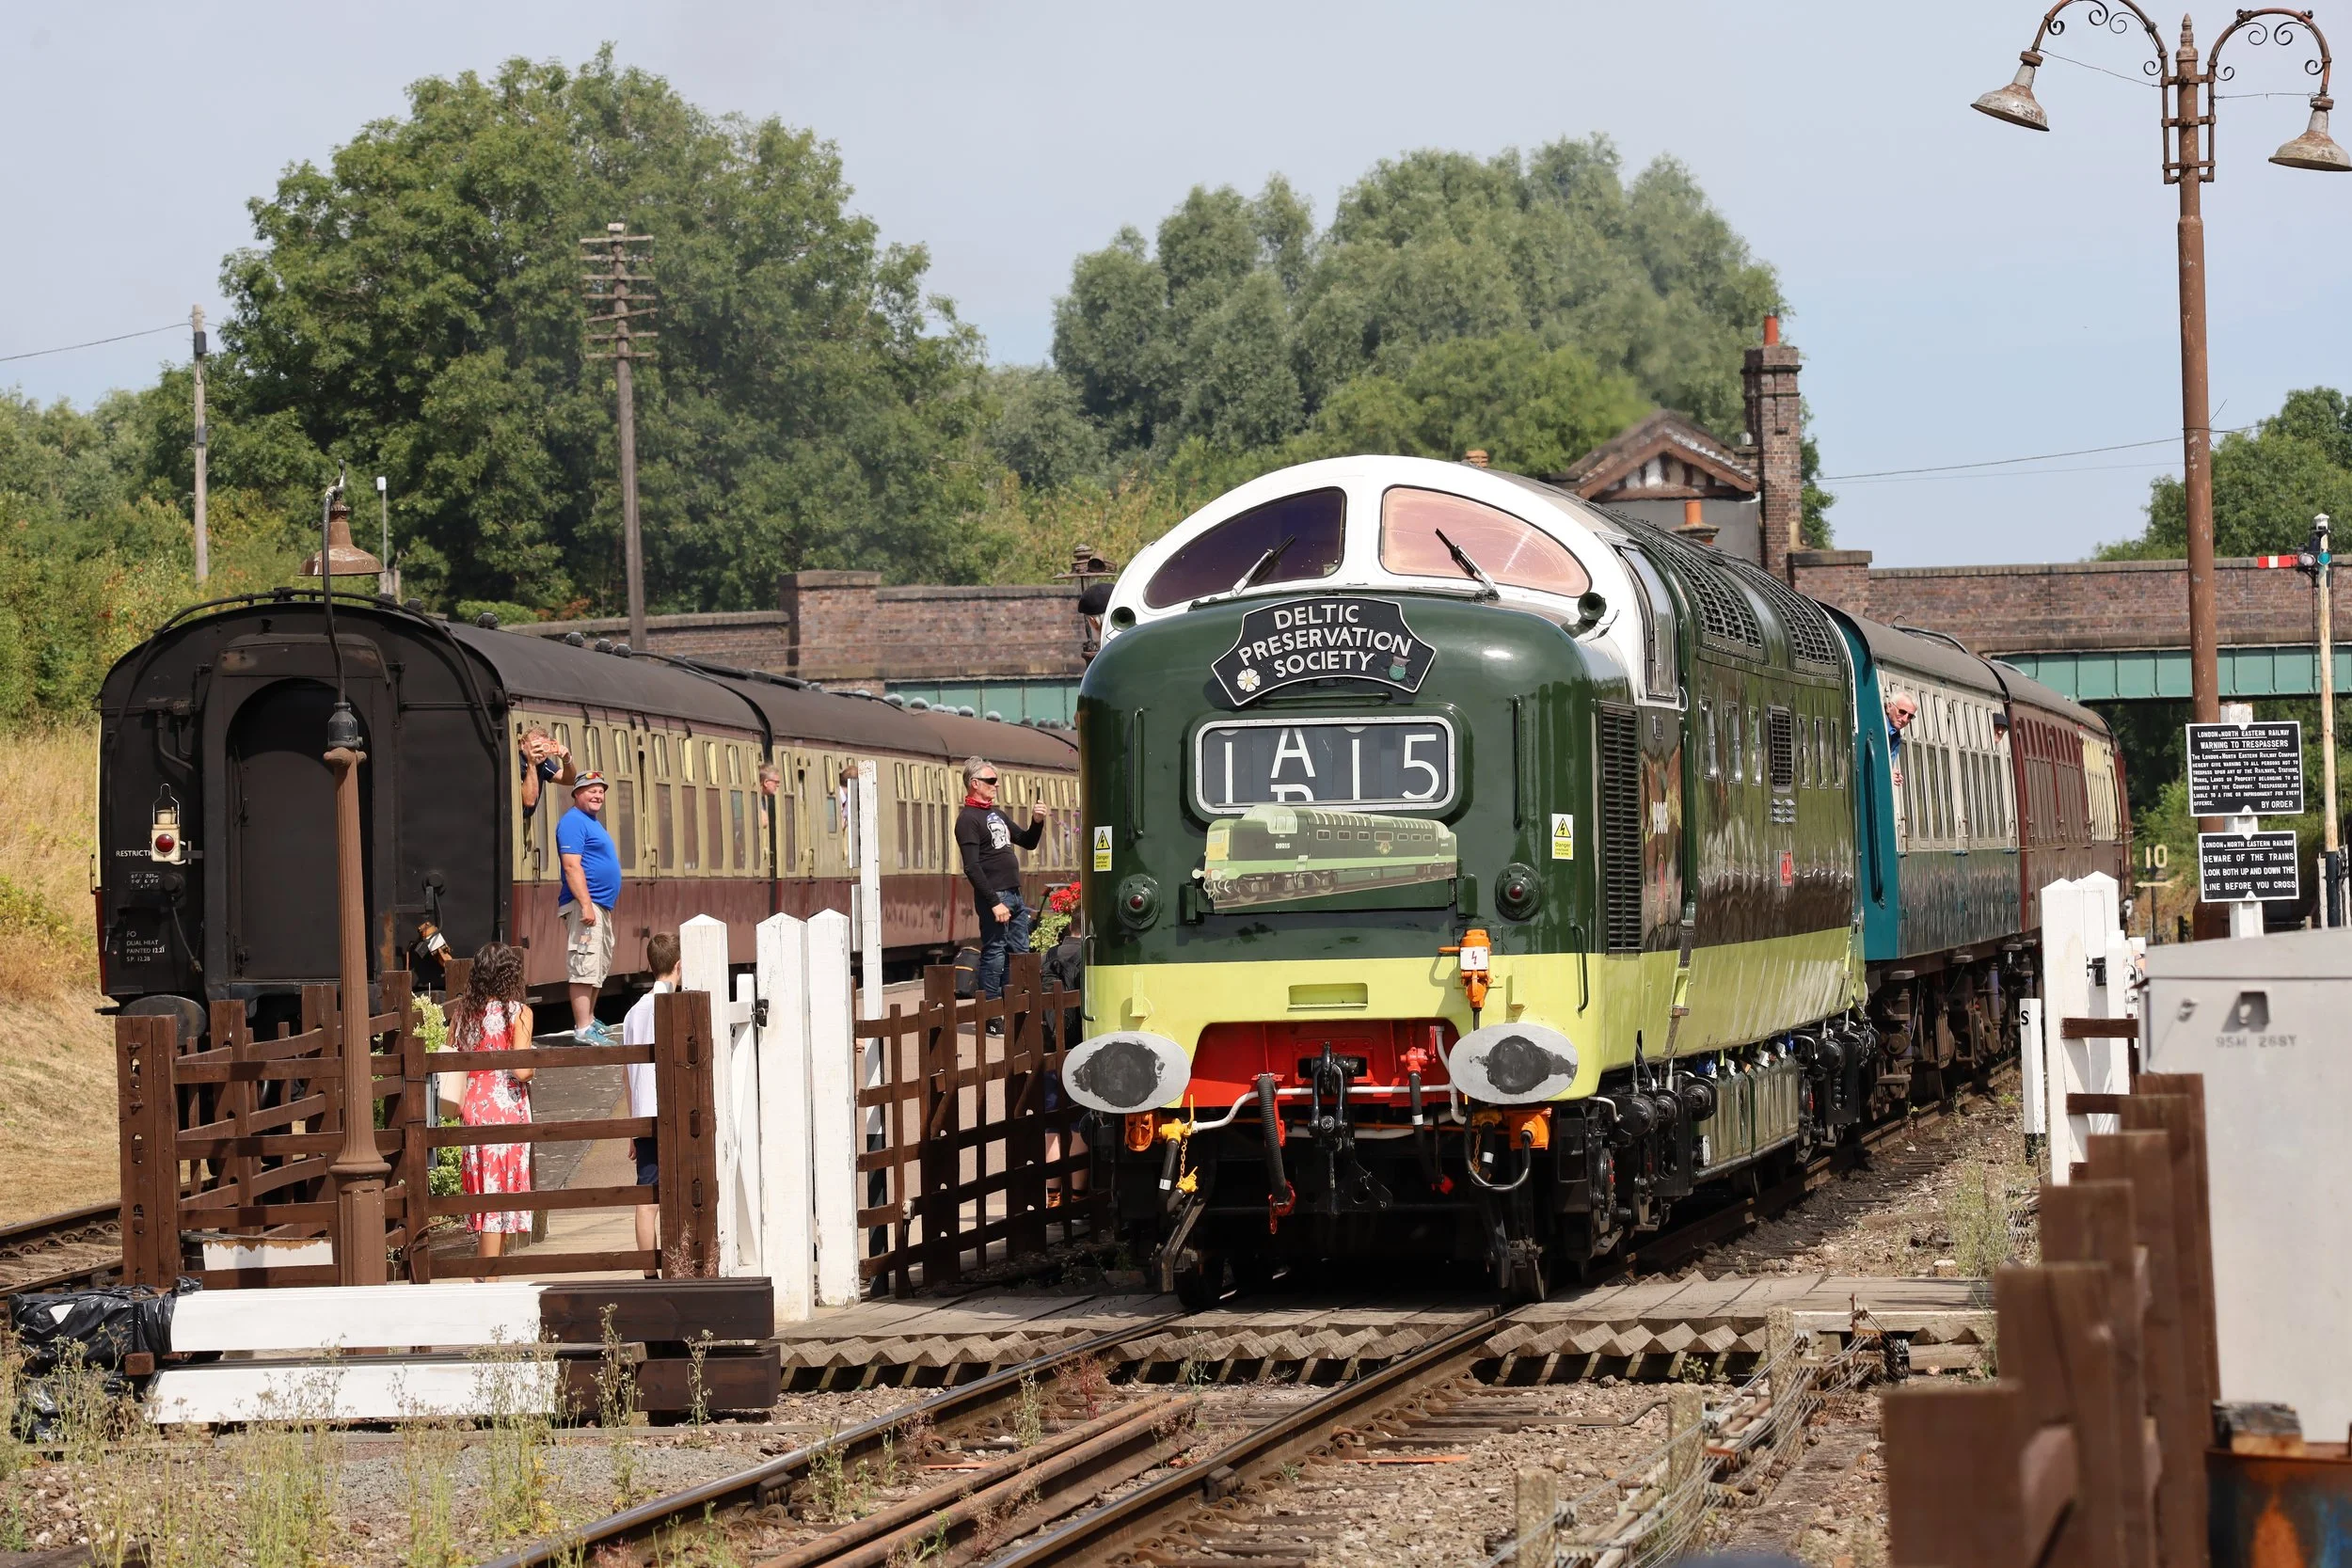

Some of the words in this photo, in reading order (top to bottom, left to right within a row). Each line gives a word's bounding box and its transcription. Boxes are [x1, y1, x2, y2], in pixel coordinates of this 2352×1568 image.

[1273, 604, 1359, 629] DELTIC
[1238, 627, 1412, 666] PRESERVATION
[1273, 650, 1376, 678] SOCIETY
[2242, 740, 2288, 748] TRESPASSERS
[1401, 734, 1440, 800] 5
[2145, 844, 2167, 869] 10
[2204, 854, 2232, 863] BEWARE
[2236, 854, 2245, 862] OF
[2269, 853, 2294, 861] TRAINS
[2225, 882, 2252, 890] BEFORE
[2020, 1010, 2029, 1025] S
